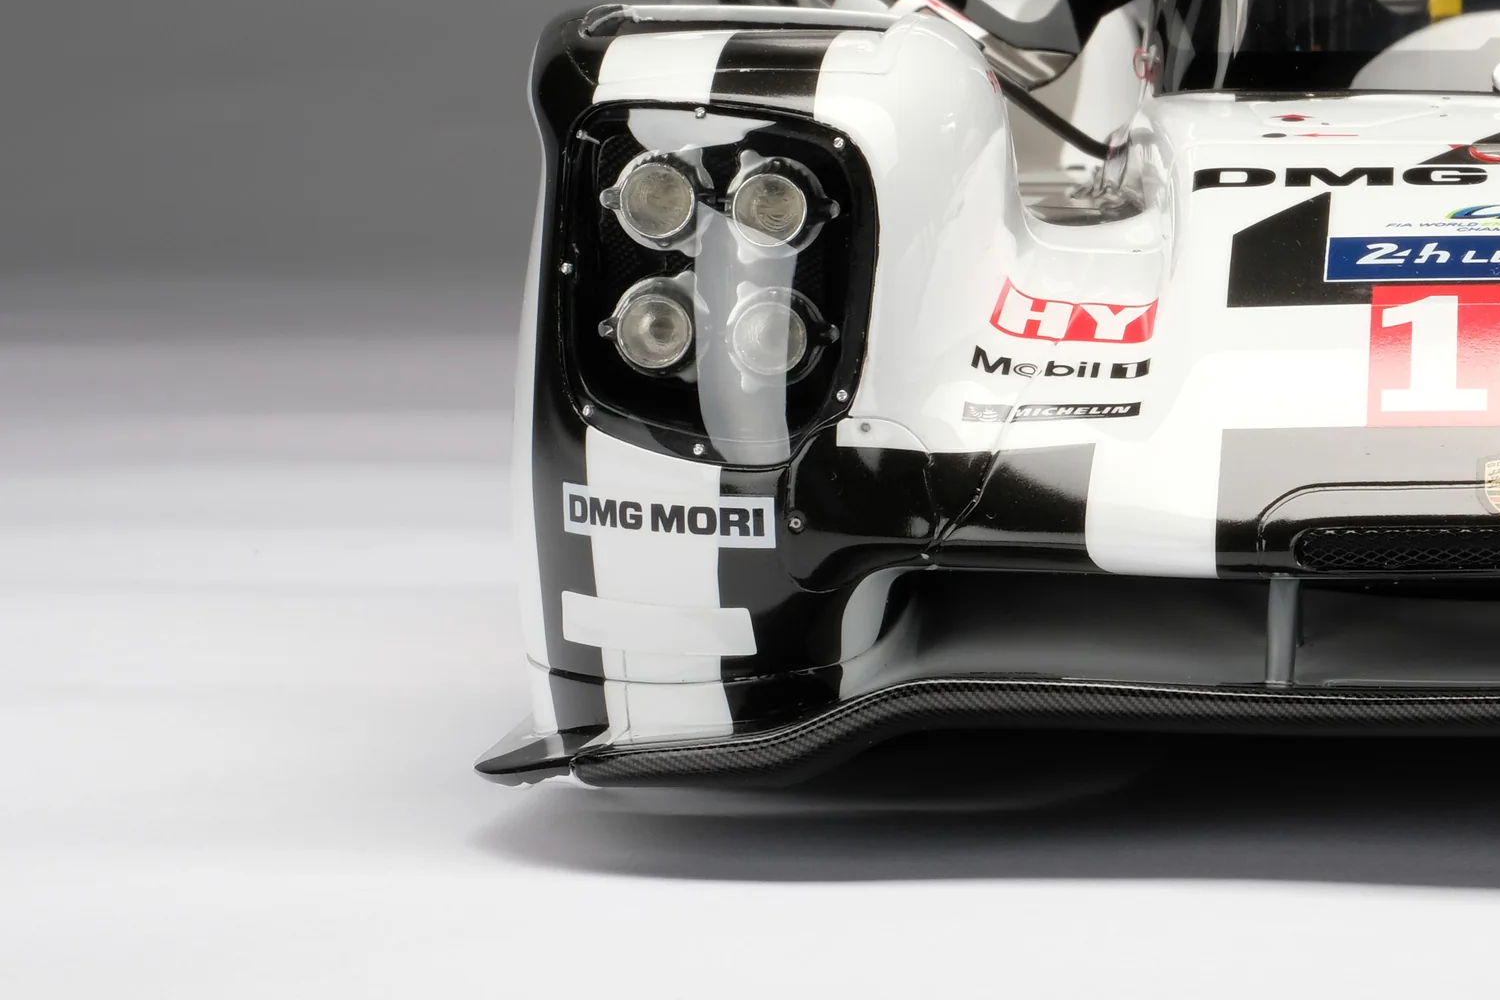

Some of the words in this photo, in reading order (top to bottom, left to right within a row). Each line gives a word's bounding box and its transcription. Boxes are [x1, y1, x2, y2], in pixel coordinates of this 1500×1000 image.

[1193, 166, 1487, 192] DMG
[997, 286, 1153, 341] HY
[971, 344, 1101, 379] Mobil
[1014, 405, 1132, 417] MICHELIN
[568, 493, 643, 530] DMG
[650, 503, 766, 537] MORI
